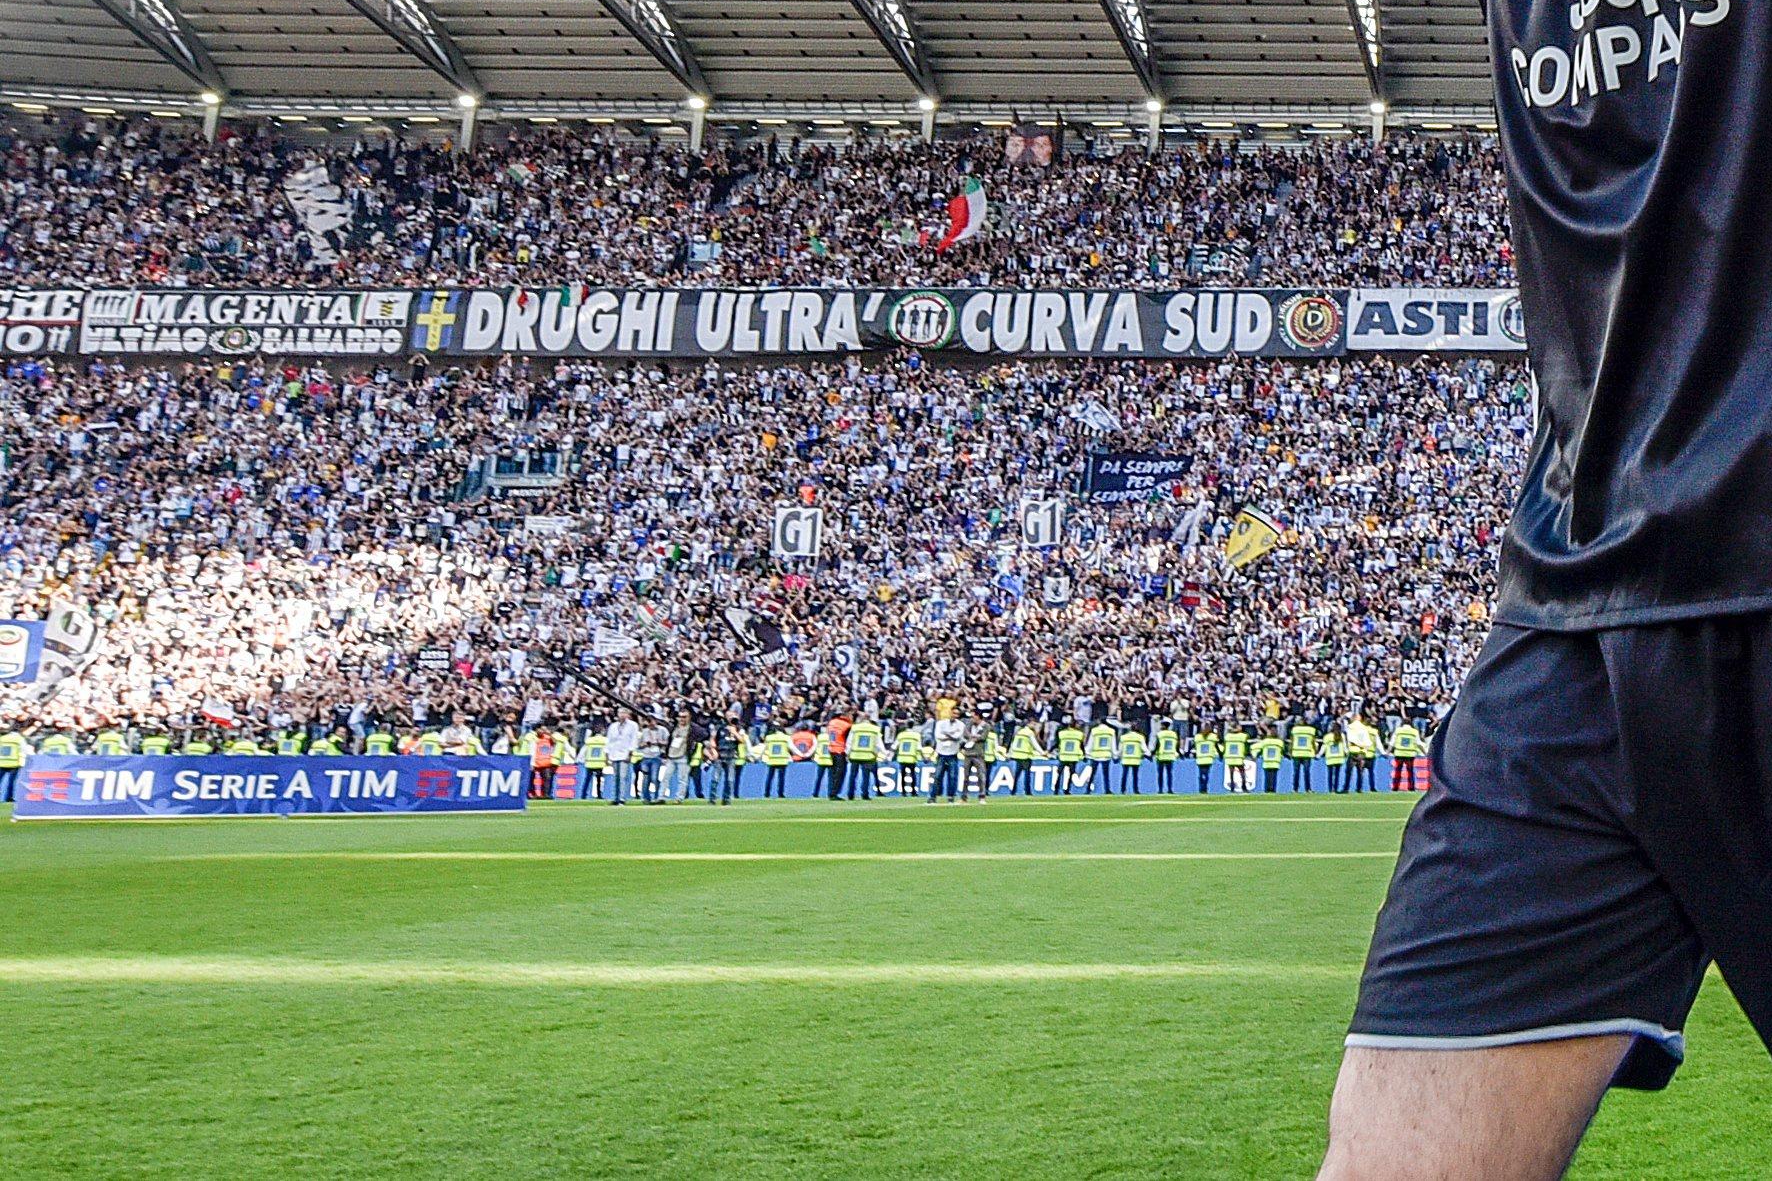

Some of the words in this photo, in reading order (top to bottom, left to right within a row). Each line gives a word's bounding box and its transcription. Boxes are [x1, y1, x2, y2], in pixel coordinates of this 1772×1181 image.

[132, 294, 355, 325] MAGENTA
[462, 290, 681, 352] DRUGHI
[960, 291, 1145, 353] CURVA
[1162, 291, 1274, 353] SUD
[1353, 300, 1489, 336] ASTI
[1126, 475, 1156, 489] PER
[1403, 659, 1437, 673] DAJE
[76, 770, 155, 801] TIM
[171, 769, 280, 800] SERIE
[283, 769, 314, 799] A
[324, 769, 399, 799] TIM
[456, 769, 522, 798] TIM
